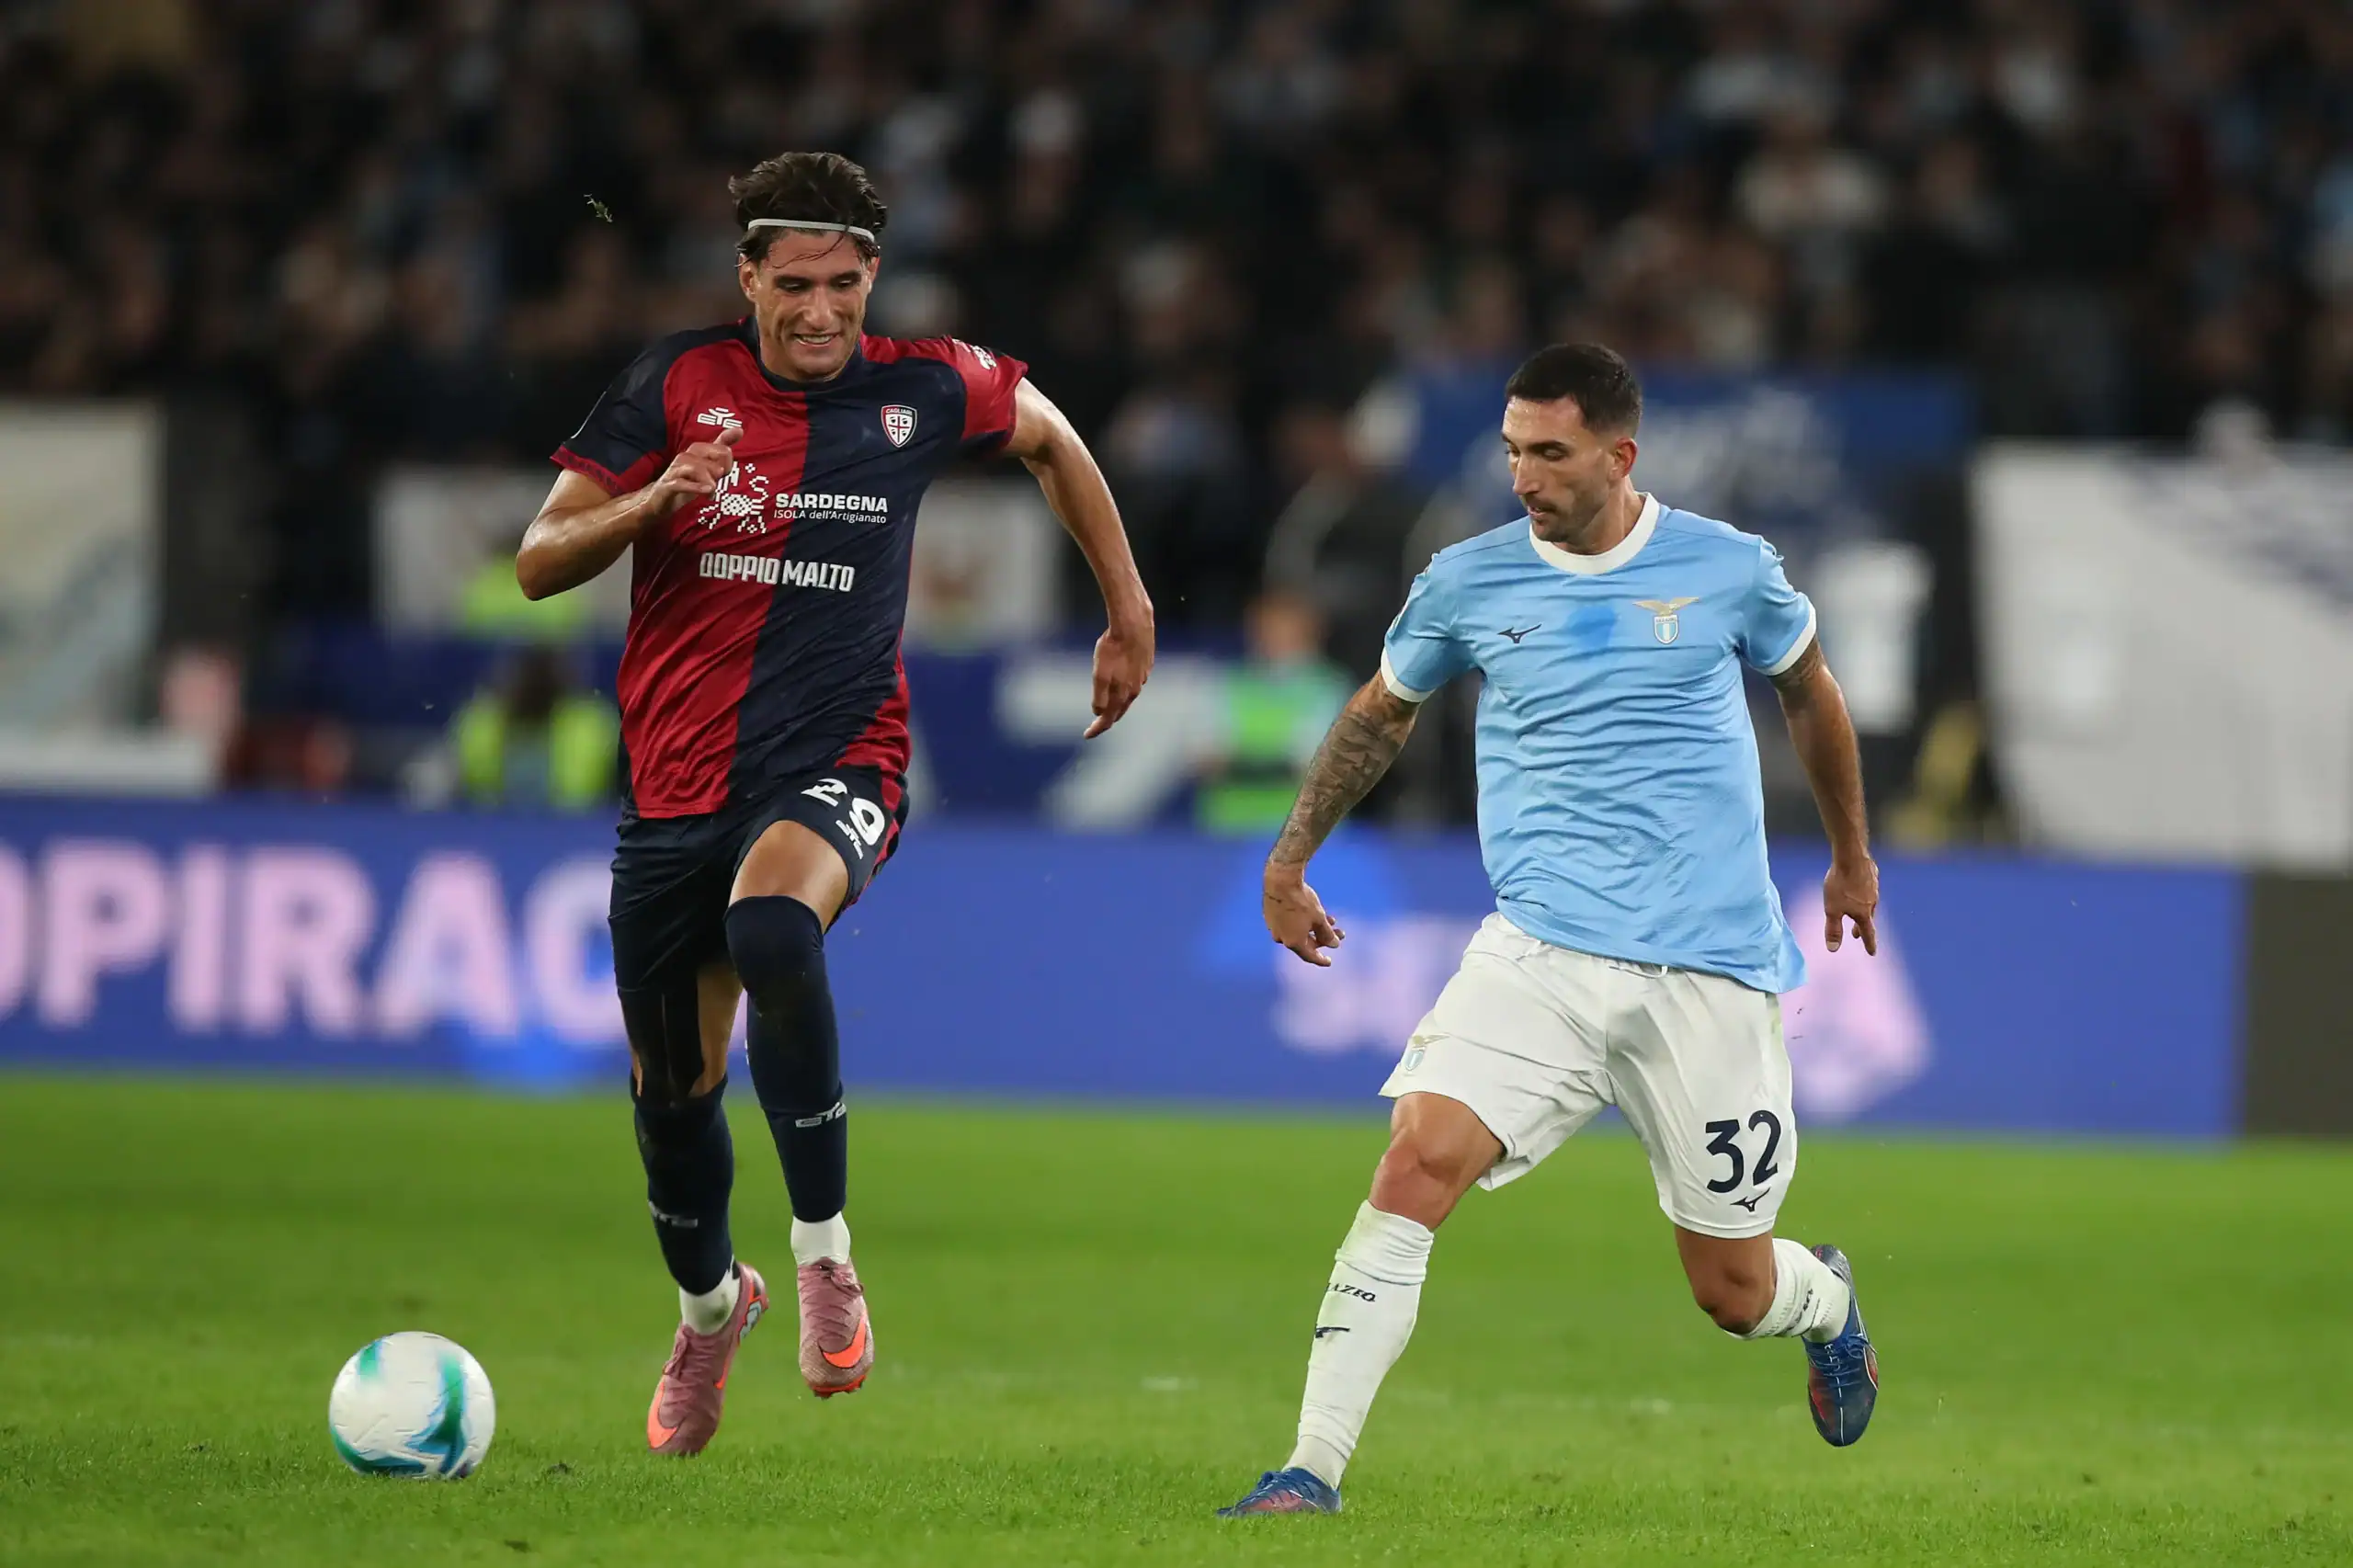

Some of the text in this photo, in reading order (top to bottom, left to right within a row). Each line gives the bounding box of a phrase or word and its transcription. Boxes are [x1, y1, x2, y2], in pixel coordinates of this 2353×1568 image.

[773, 509, 887, 524] ISOLA dell'Artigianato
[775, 493, 889, 513] SARDEGNA
[699, 551, 856, 593] DOPPIO MALTO
[1705, 1109, 1781, 1193] 32
